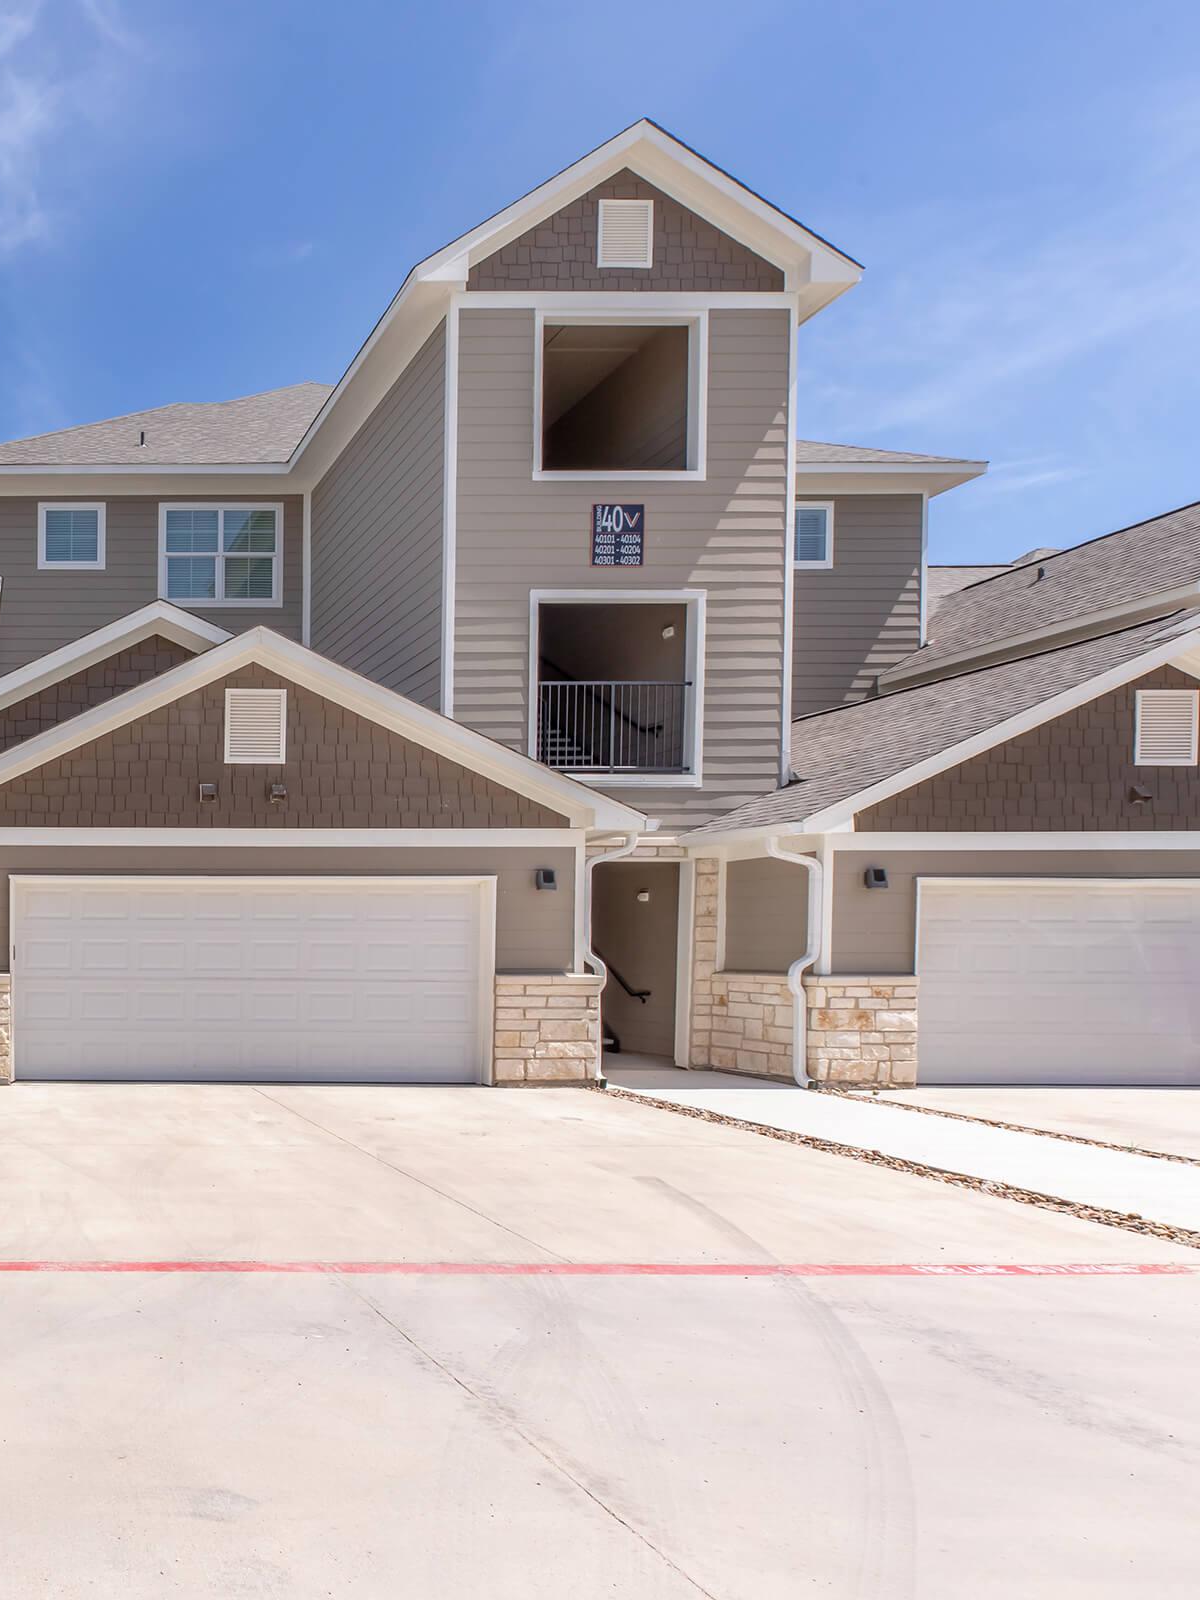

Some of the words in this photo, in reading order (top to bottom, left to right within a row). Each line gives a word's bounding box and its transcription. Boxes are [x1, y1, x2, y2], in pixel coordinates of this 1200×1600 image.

[602, 505, 623, 532] 40
[595, 534, 615, 544] 40101
[621, 534, 641, 544] 40104
[595, 545, 615, 554] 40201
[620, 545, 641, 554] 40204
[594, 556, 615, 565] 40301
[620, 556, 641, 565] 40302
